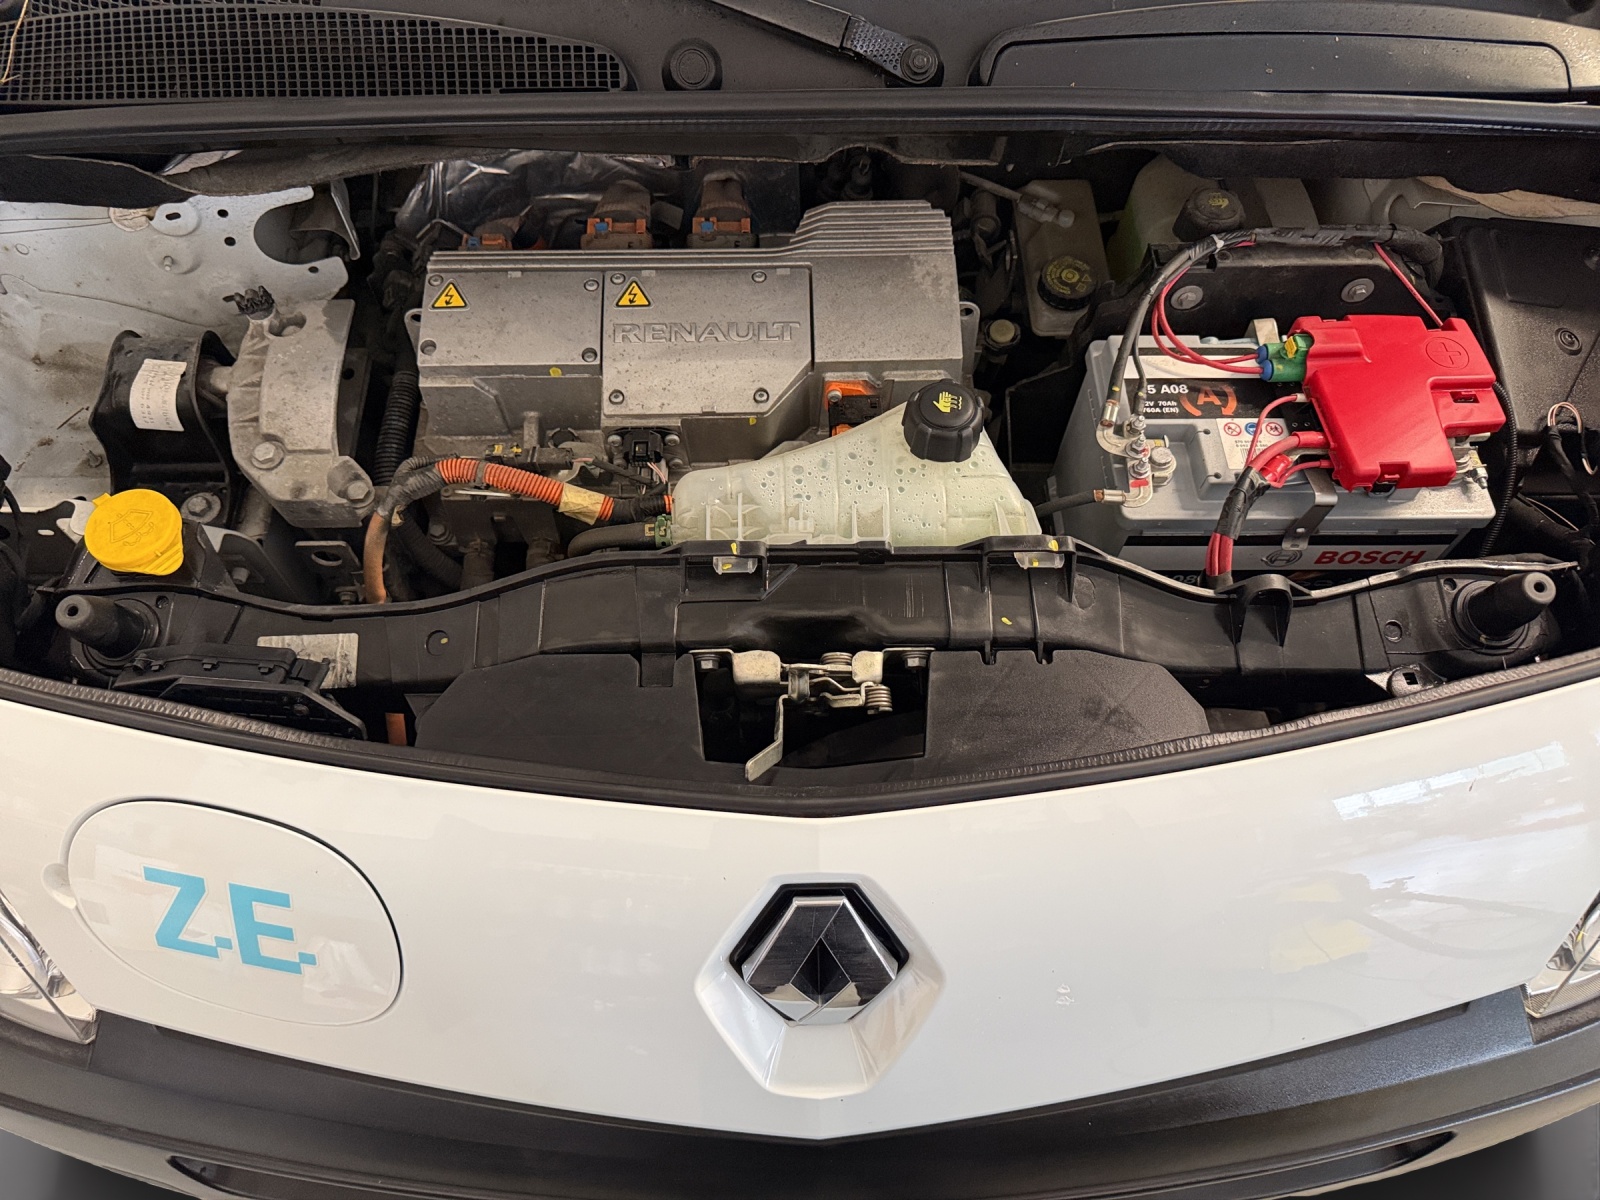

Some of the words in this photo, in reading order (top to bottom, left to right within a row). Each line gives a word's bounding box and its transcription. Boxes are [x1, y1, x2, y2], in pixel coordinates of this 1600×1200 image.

[612, 321, 800, 344] RENAULT
[1160, 384, 1189, 394] A08
[1313, 550, 1427, 565] BOSCH
